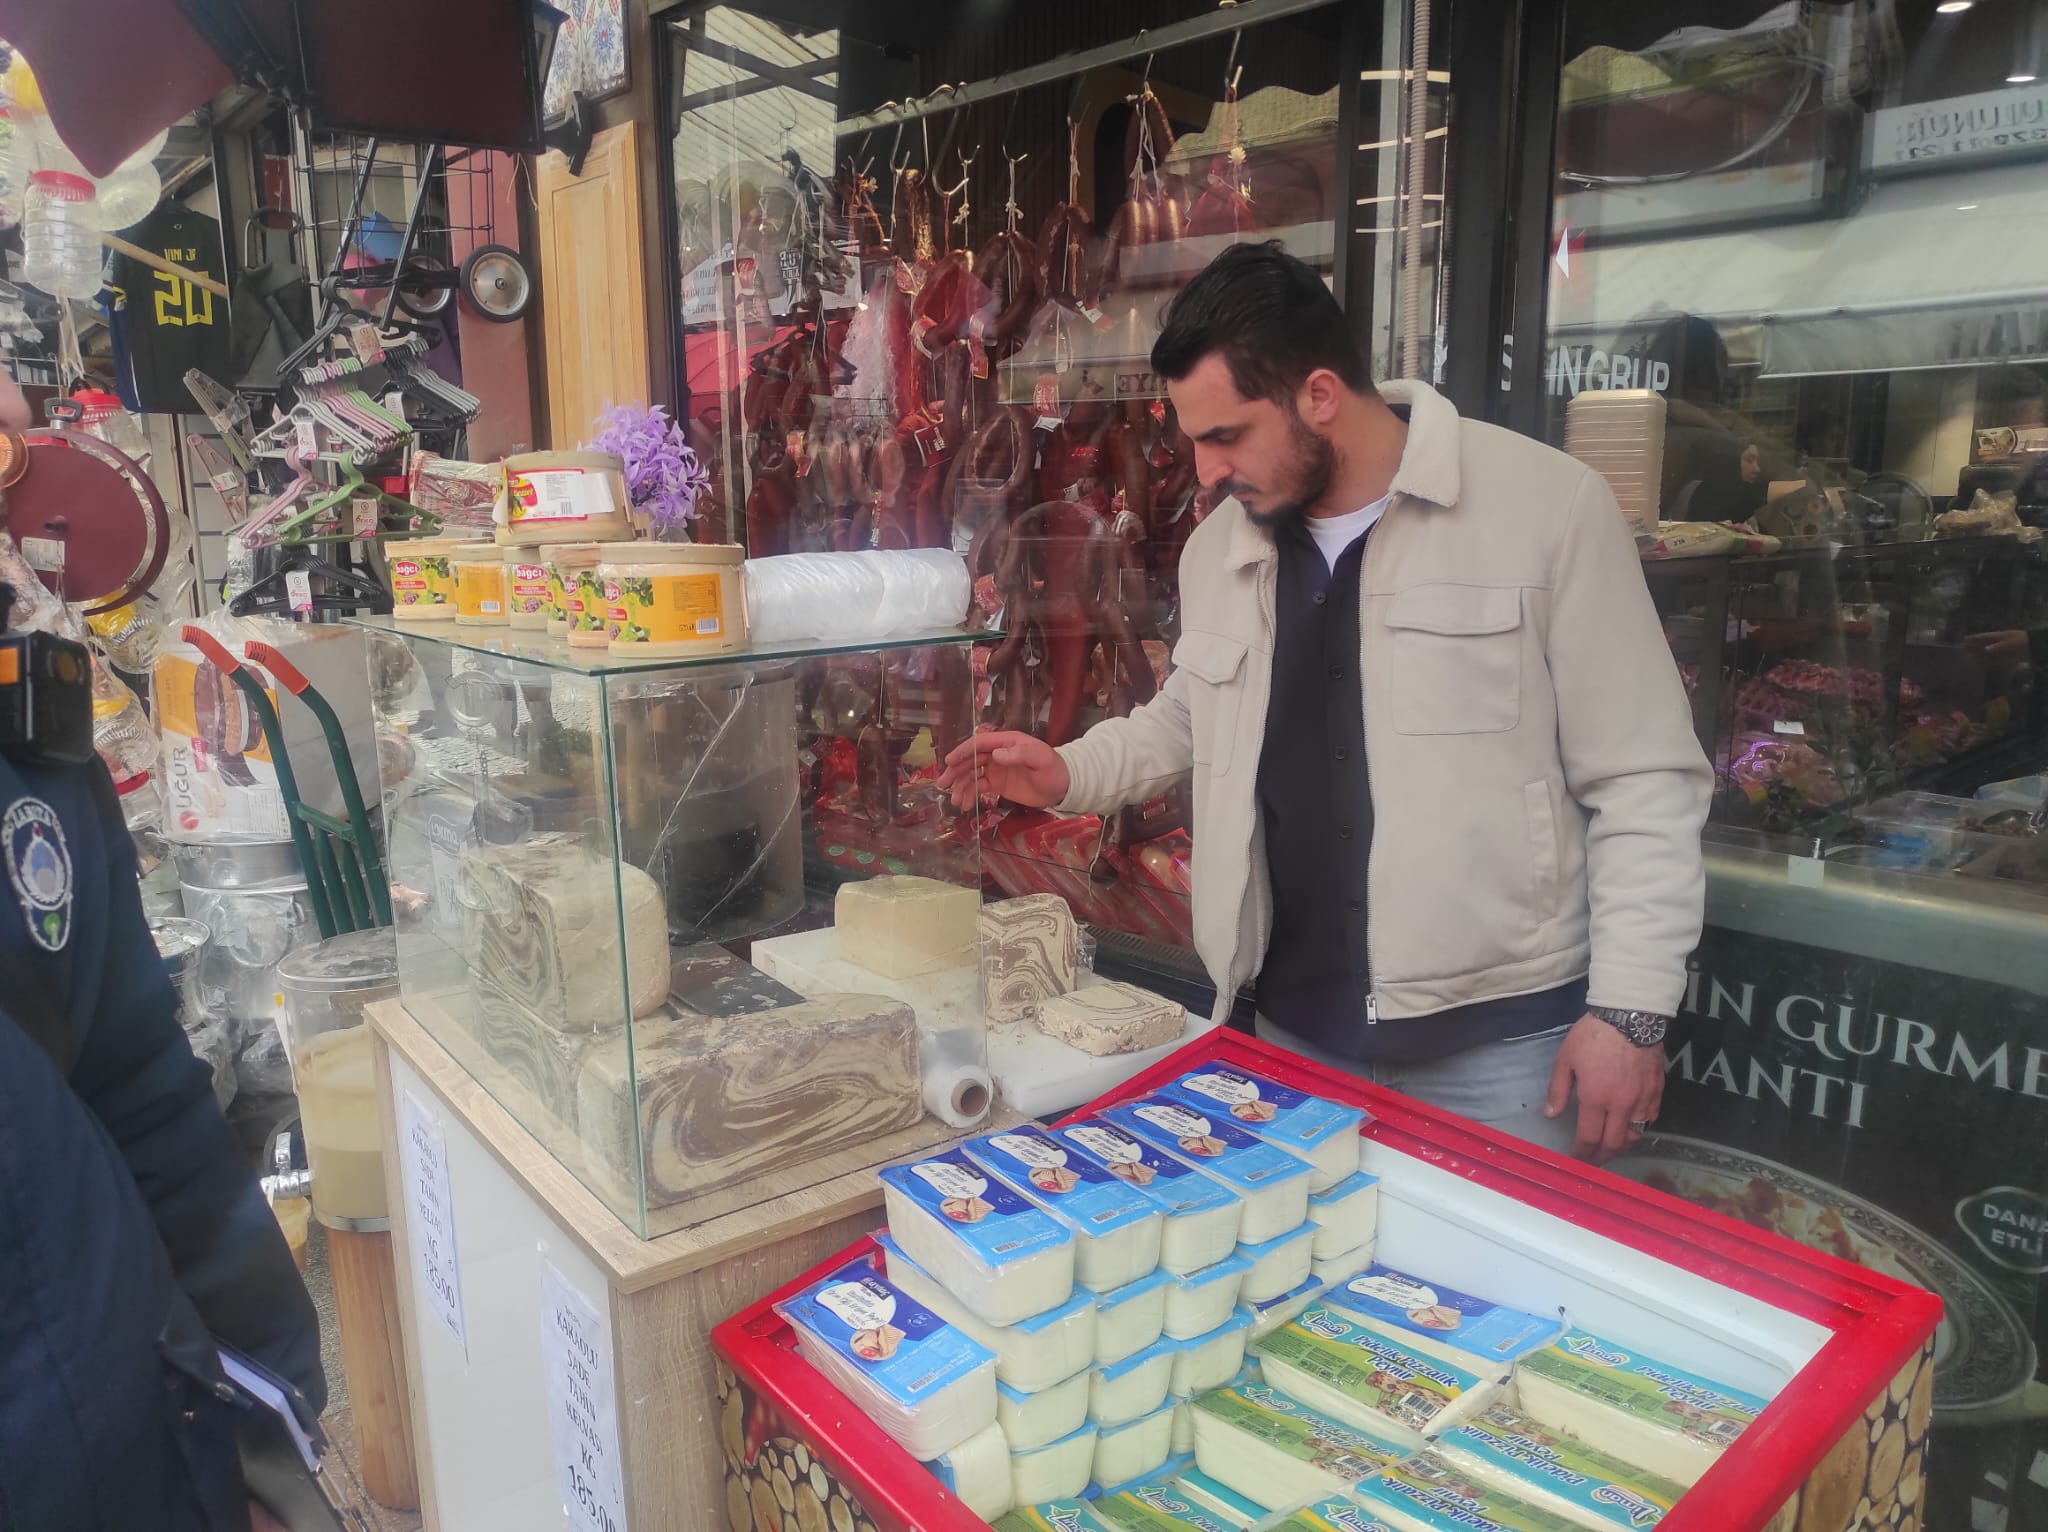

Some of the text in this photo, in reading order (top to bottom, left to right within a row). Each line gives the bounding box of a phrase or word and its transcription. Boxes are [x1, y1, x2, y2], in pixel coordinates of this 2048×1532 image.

[164, 248, 182, 261] VINI
[154, 270, 213, 326] 20
[556, 1308, 599, 1370] KAKAOLU
[567, 1348, 591, 1390] SADE
[1366, 1355, 1416, 1381] Peynir
[580, 1440, 597, 1480] KG
